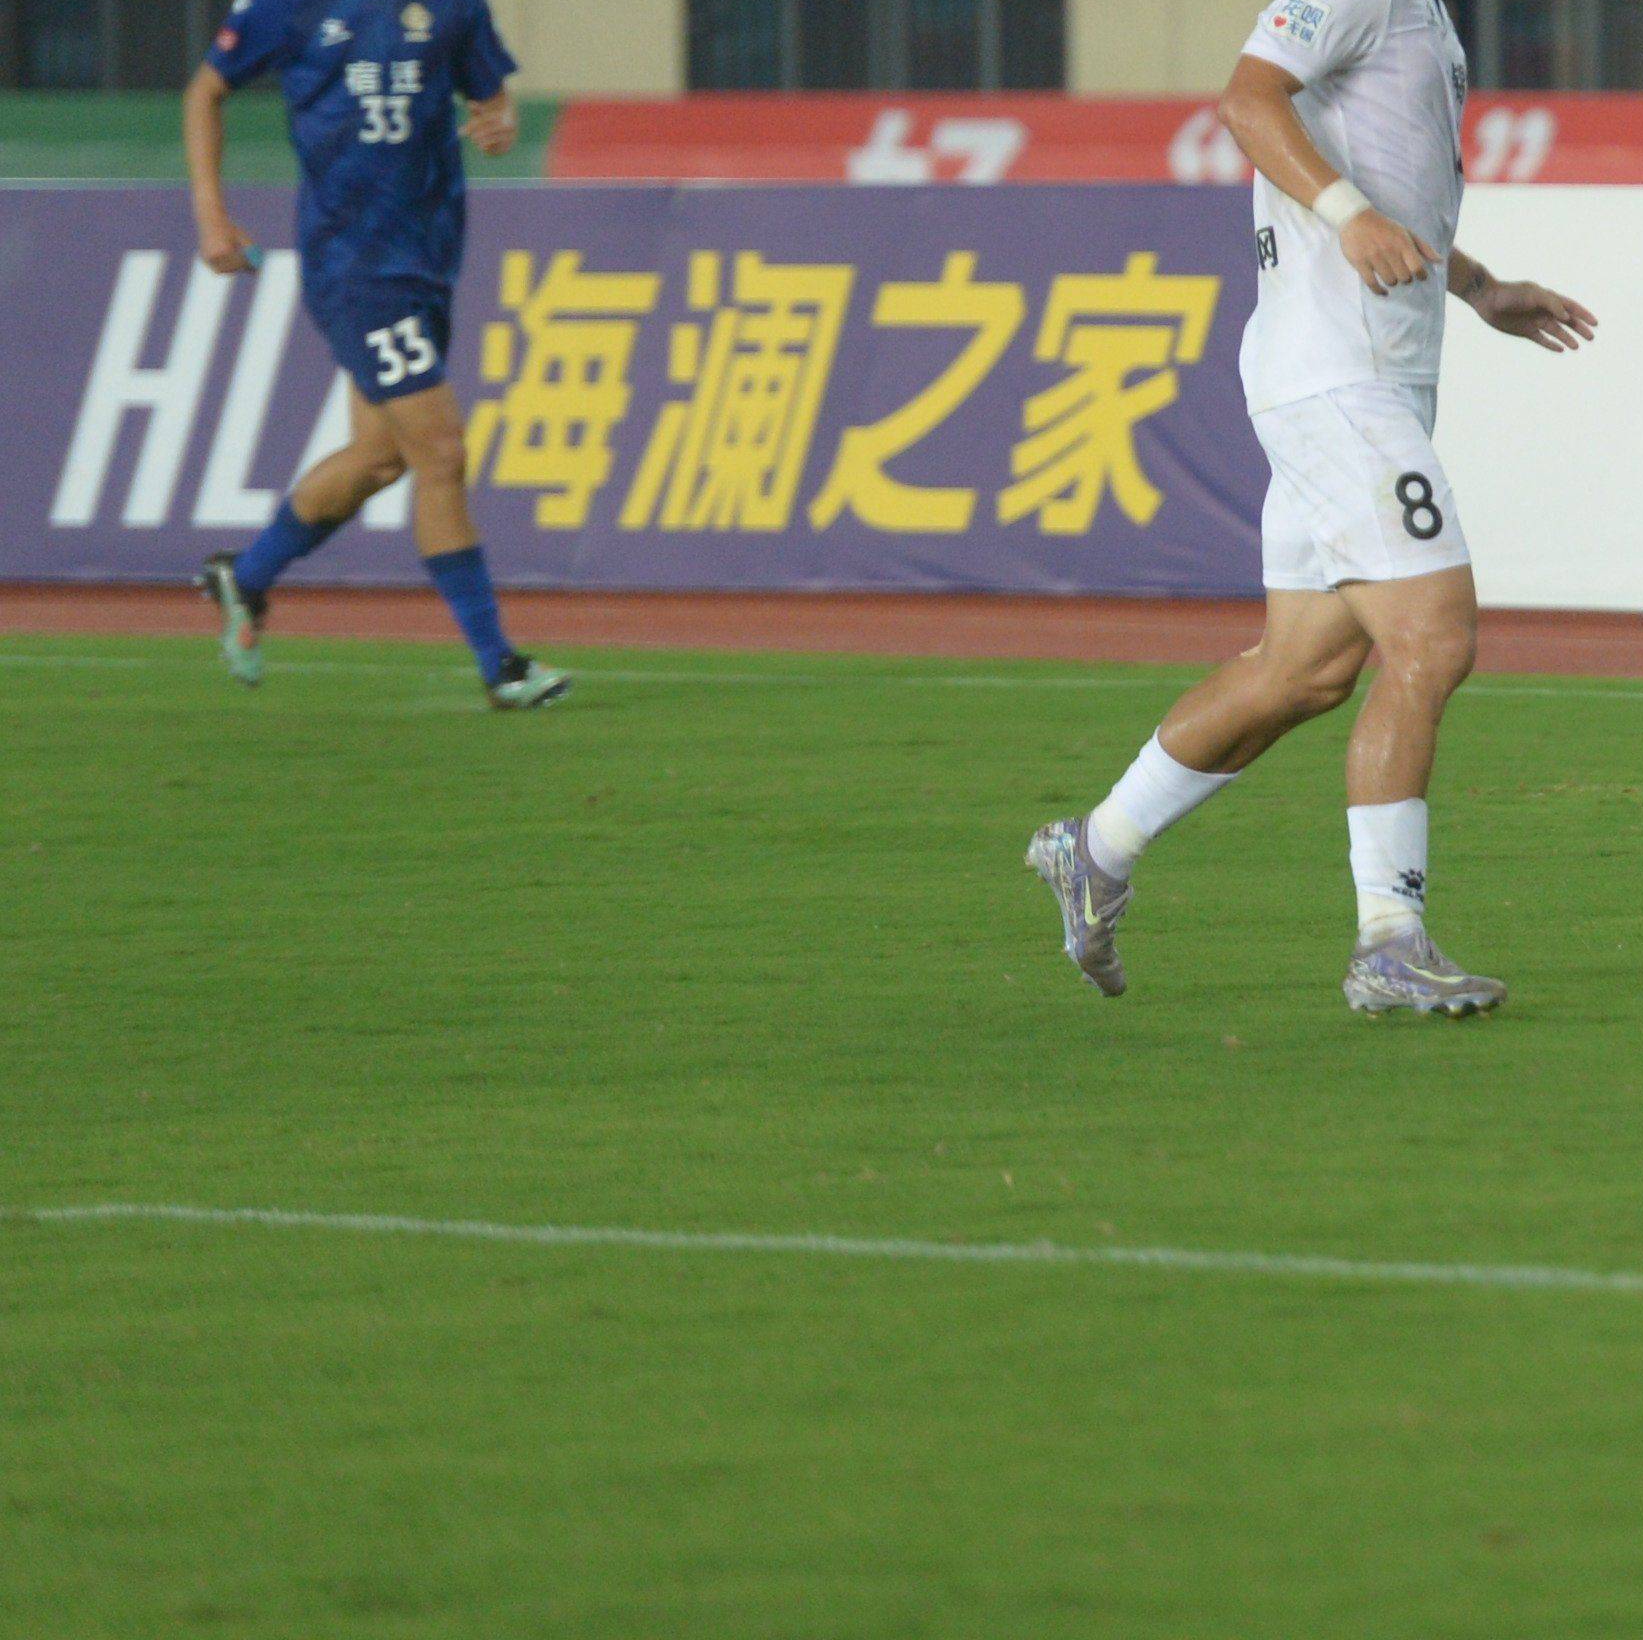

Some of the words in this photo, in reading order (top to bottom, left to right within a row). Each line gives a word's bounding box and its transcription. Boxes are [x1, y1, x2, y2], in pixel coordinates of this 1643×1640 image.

[357, 95, 413, 144] 33
[365, 315, 437, 387] 33
[464, 248, 1220, 535] 海澜之家
[1395, 470, 1444, 541] 8
